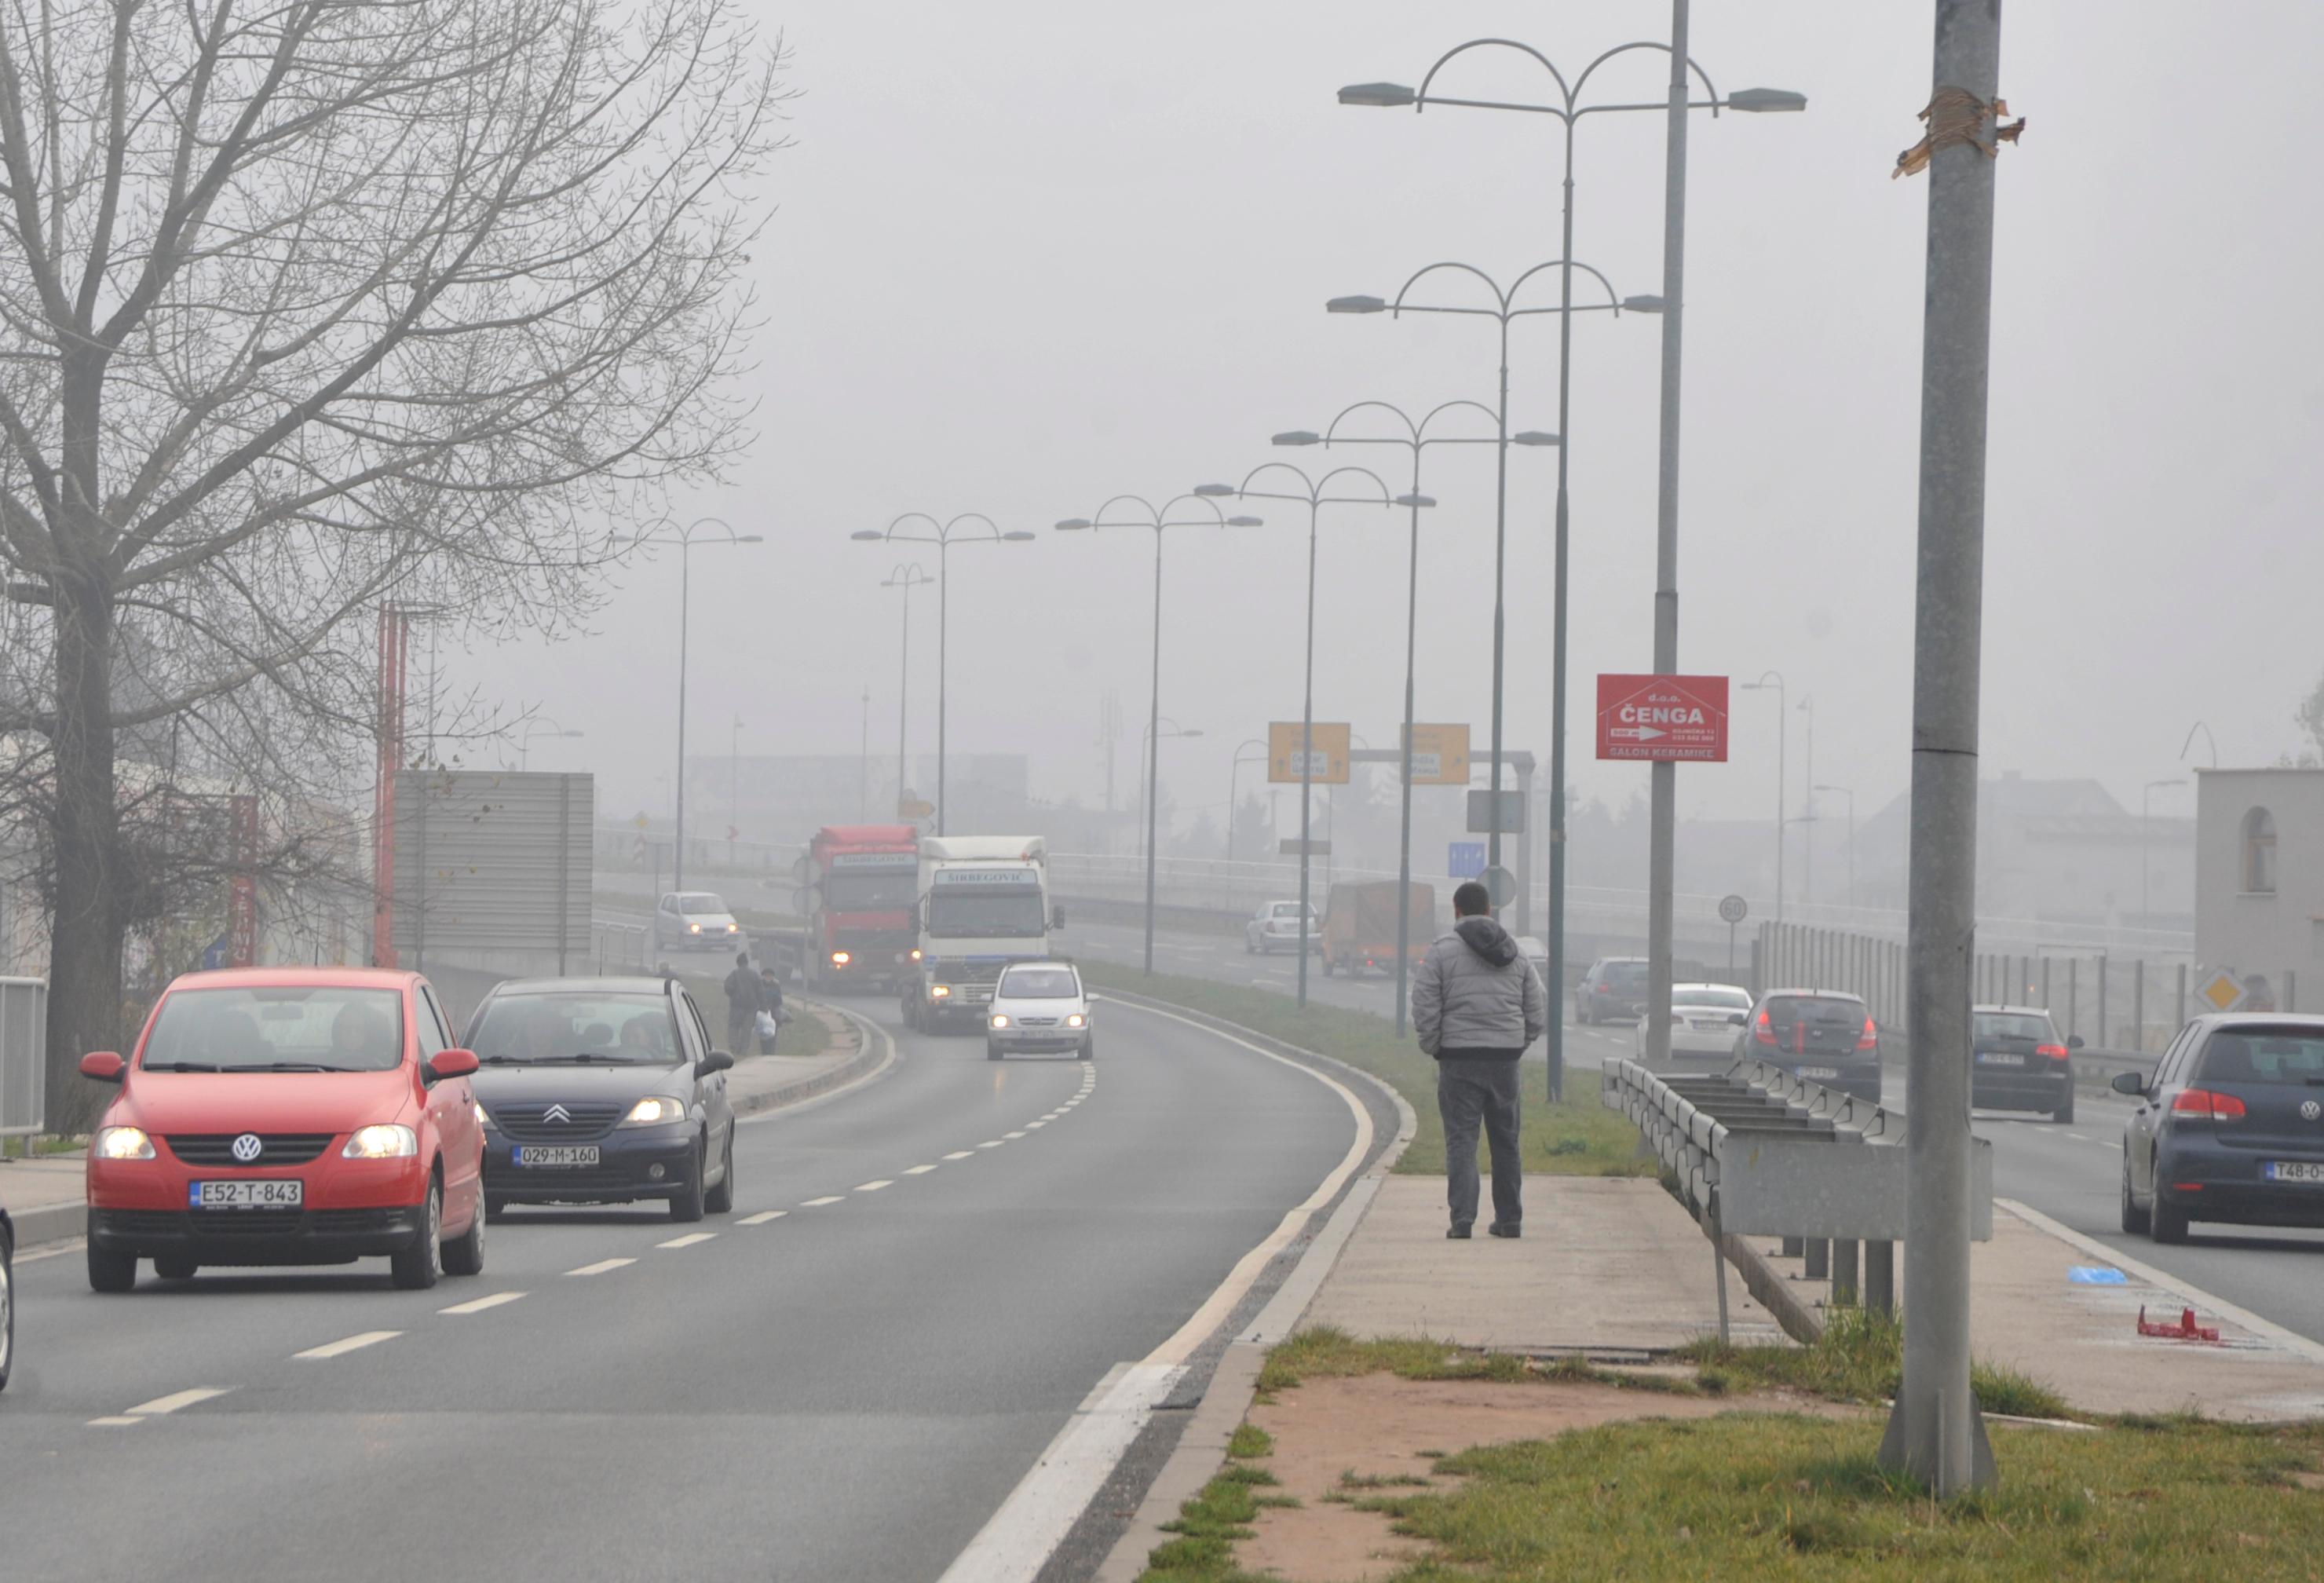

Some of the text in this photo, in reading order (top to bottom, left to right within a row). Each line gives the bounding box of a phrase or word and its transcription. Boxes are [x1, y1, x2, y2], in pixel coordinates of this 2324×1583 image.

[1620, 704, 1705, 724] ČENGA
[1610, 748, 1715, 759] SALON KERAMIKE
[948, 871, 1024, 882] ŠIRBEGOVIĆ
[522, 1148, 597, 1162] 029-M-160
[203, 1183, 298, 1201] E52-T-843
